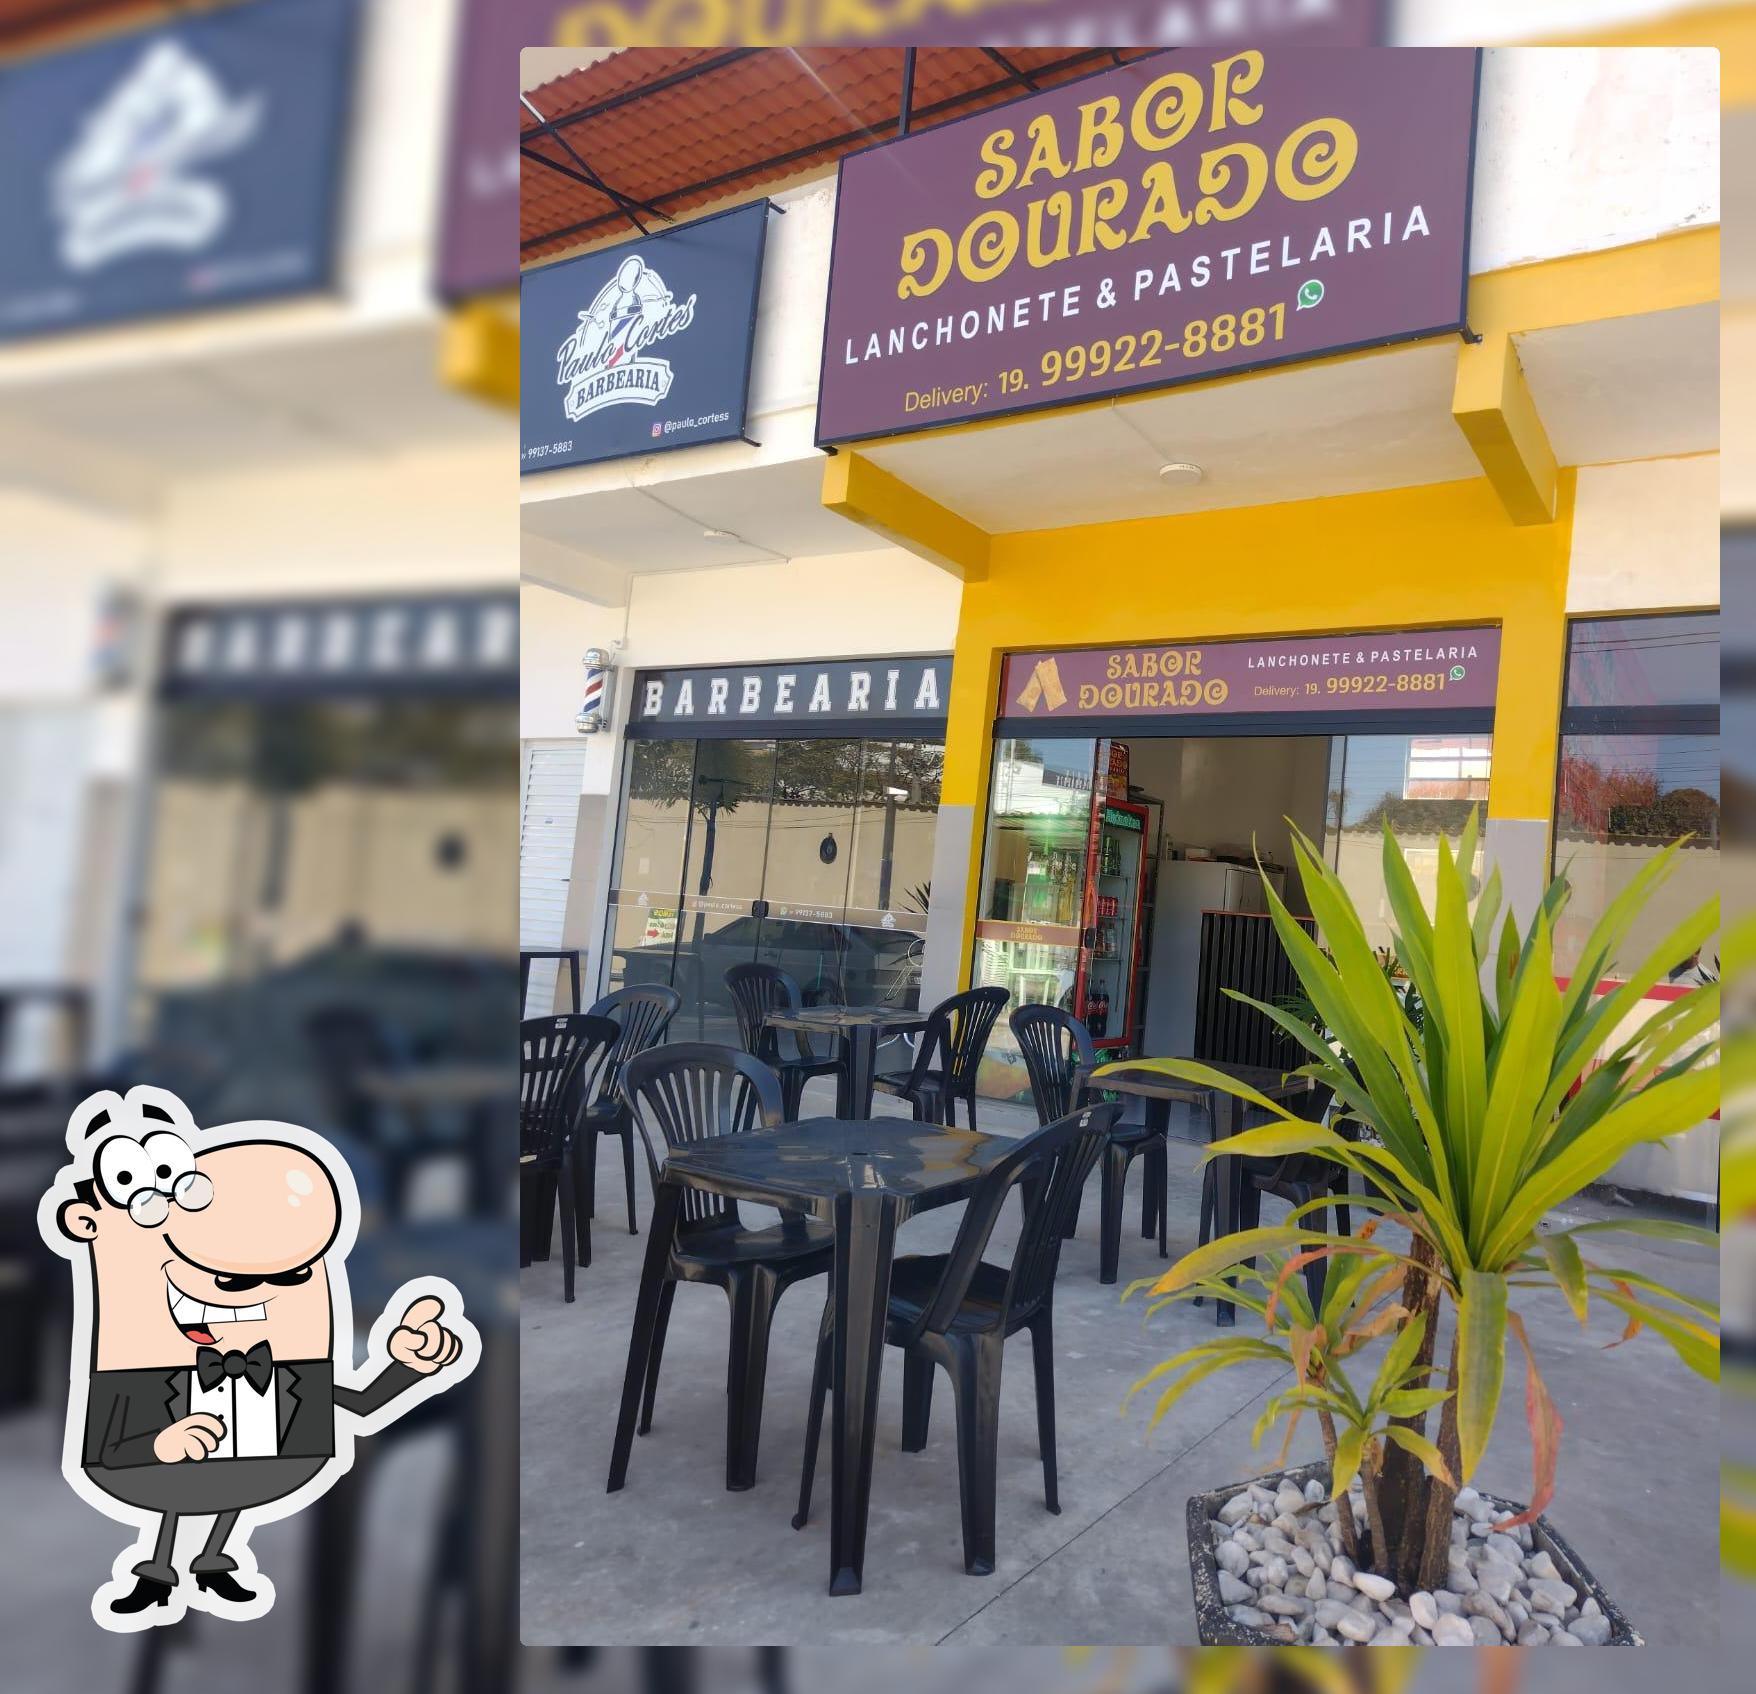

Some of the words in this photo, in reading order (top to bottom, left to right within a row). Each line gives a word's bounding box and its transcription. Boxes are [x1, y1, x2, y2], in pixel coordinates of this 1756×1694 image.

[975, 50, 1265, 199] SABOR
[897, 117, 1358, 300] DOURADO
[845, 278, 1080, 365] LANCHONETE
[1097, 278, 1117, 309] &
[1135, 205, 1431, 302] PASTELARIA
[558, 331, 615, 382] Paulo
[624, 297, 695, 352] Cortes
[904, 378, 989, 413] Delivery:
[998, 368, 1030, 396] 19.
[1041, 302, 1287, 387] 99922-8881
[575, 368, 661, 409] BARBEARIA
[664, 411, 730, 433] @paulo_cortess
[528, 440, 573, 459] 99137-5883
[1106, 650, 1203, 679] SABOR
[1247, 651, 1351, 668] LANCHONETE
[1355, 650, 1366, 664] &
[1370, 646, 1479, 664] PASTELARIA
[643, 667, 941, 717] BARBEARIA
[1077, 679, 1229, 710] DOURADO
[1253, 683, 1300, 698] Delivery:
[1304, 682, 1321, 695] 19.
[1326, 672, 1447, 694] 99922-8881
